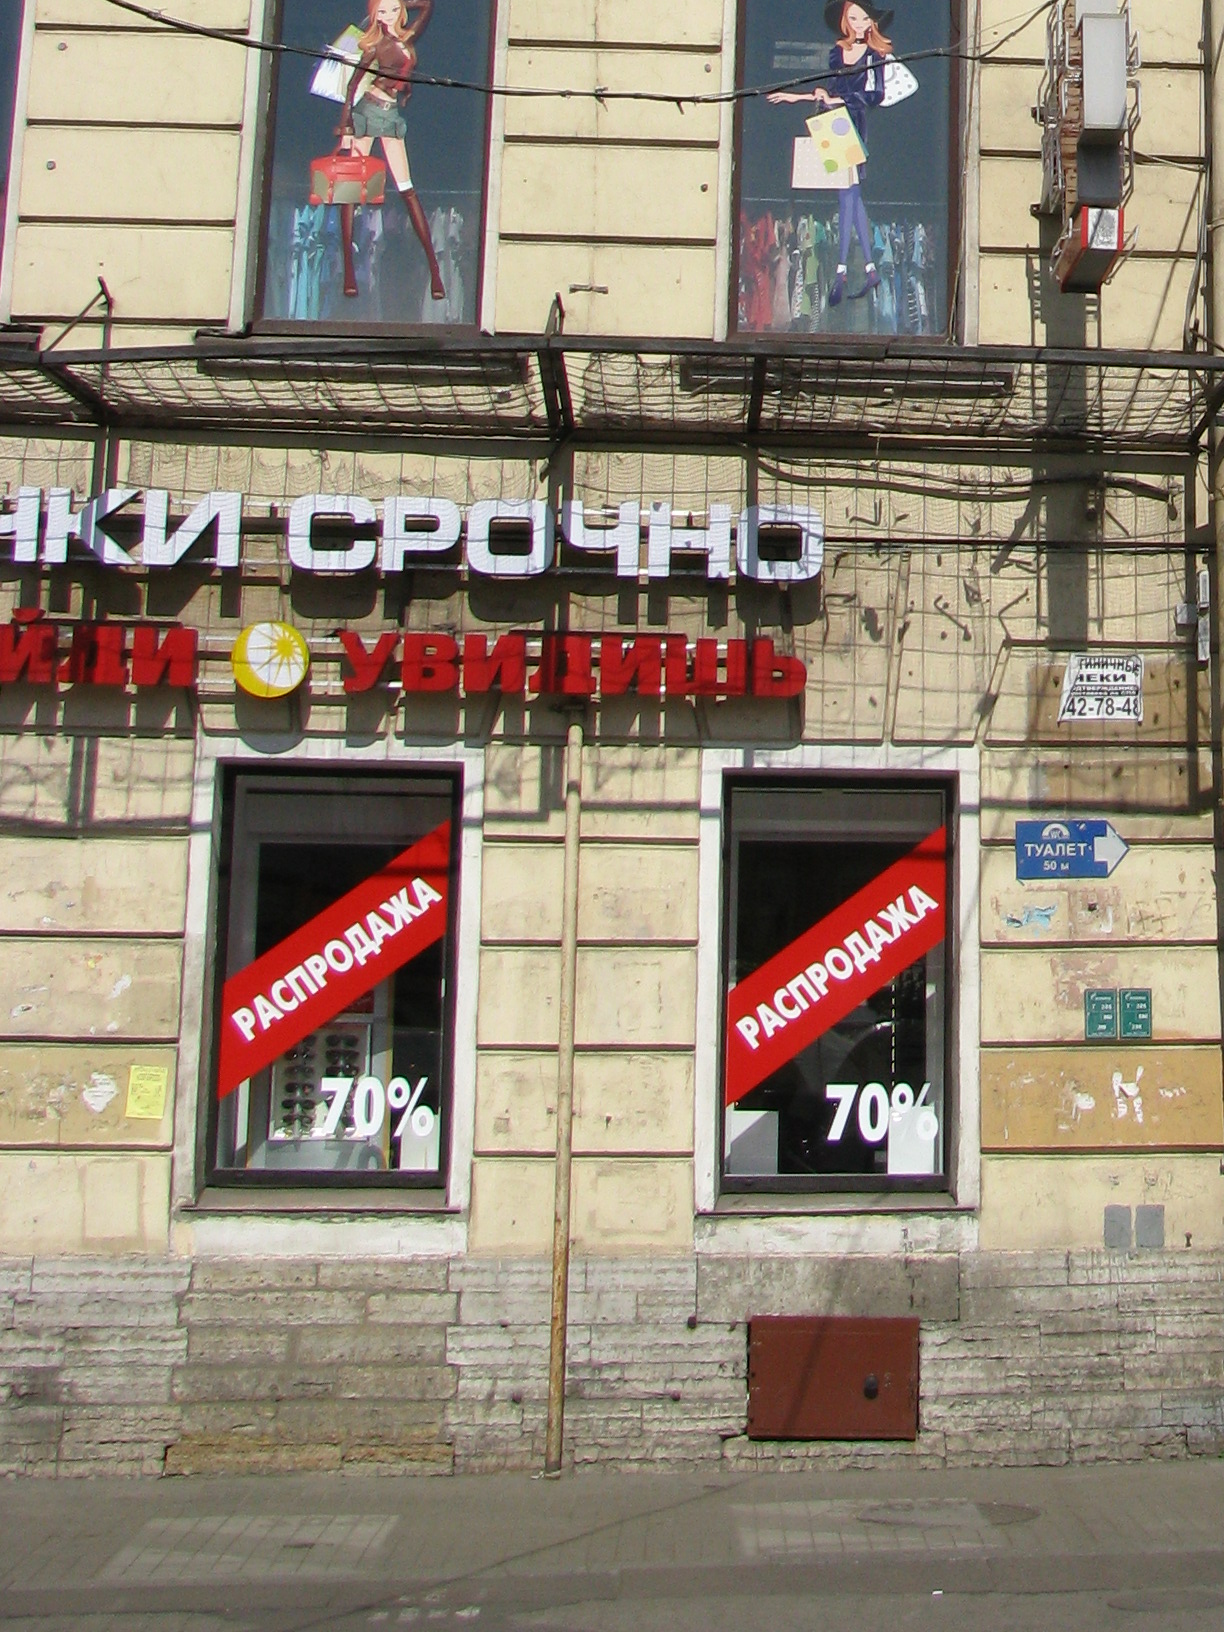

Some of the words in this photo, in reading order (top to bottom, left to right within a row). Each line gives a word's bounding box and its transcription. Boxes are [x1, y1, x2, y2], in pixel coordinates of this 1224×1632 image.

[286, 493, 825, 581] СРОЧНО
[338, 632, 808, 698] УВИДИШЬ
[1024, 842, 1087, 857] ТУАЛЕТ
[1043, 860, 1057, 871] 50
[231, 876, 443, 1042] РАСПРОДАЖА
[735, 884, 939, 1050] РАСПРОДАЖА
[319, 1076, 435, 1139] 70%
[825, 1081, 940, 1143] 70%
